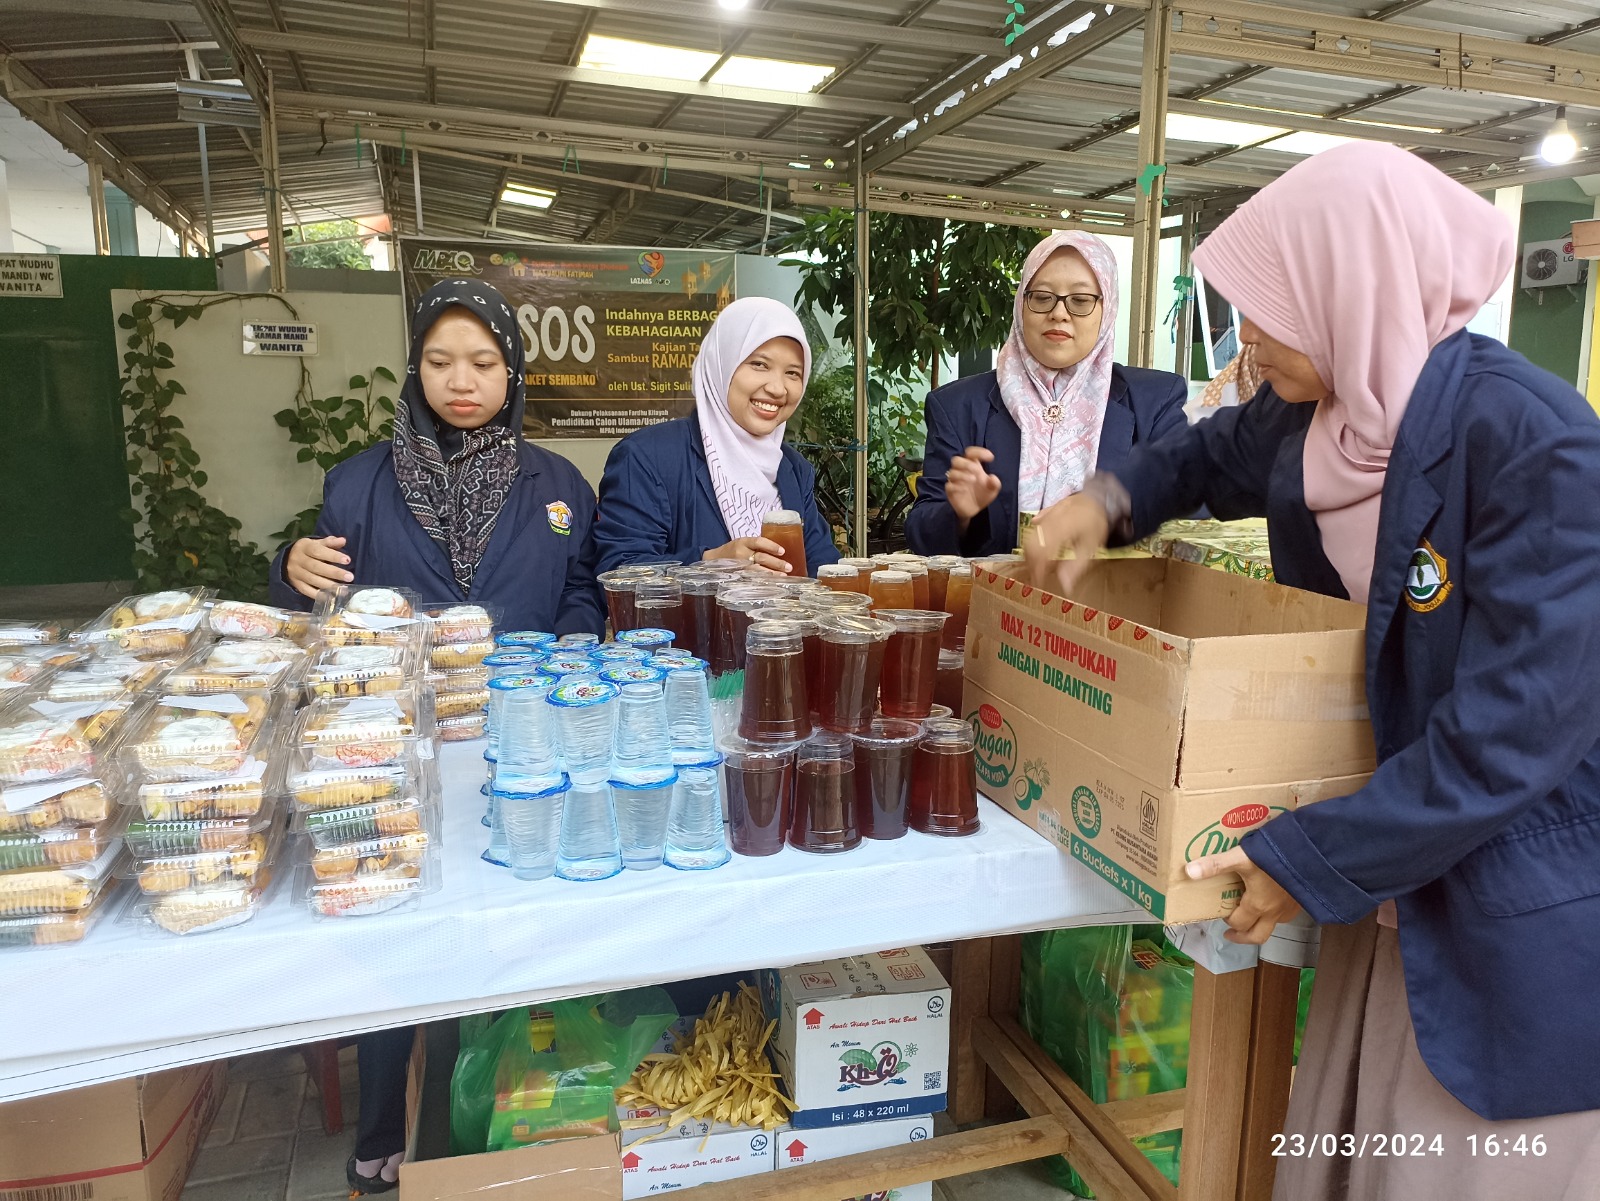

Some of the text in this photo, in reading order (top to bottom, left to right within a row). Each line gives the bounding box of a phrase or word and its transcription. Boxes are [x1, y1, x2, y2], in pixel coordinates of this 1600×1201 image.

[19, 260, 54, 269] WUDHU
[2, 271, 32, 280] MANDI
[40, 272, 54, 281] WC
[605, 309, 721, 324] Indahnya BERBAG
[255, 332, 282, 340] KAMAR
[606, 325, 702, 337] KEBAHAGIAAN
[260, 343, 304, 352] WANITA
[652, 343, 687, 354] Kajian
[607, 353, 649, 363] Sambut
[549, 374, 596, 386] SEMBAKO
[608, 381, 629, 391] oleh
[630, 382, 648, 391] Ust.
[651, 382, 672, 393] Sigit
[552, 418, 594, 426] Pendidikan
[596, 418, 616, 426] Calon
[1001, 611, 1117, 682] MAX 12 TUMPUKAN
[997, 642, 1112, 716] JANGAN DIBANTING
[1226, 806, 1264, 825] WONG COCO
[1057, 834, 1069, 849] SLICE
[1073, 842, 1080, 855] 6
[1082, 846, 1119, 883] Buckets
[1121, 877, 1128, 890] x
[1131, 880, 1135, 895] 1
[1138, 885, 1153, 909] kg
[829, 1022, 848, 1030] Awali
[850, 1021, 870, 1029] Hidup
[871, 1019, 887, 1027] Dari
[841, 1040, 861, 1048] Minum
[832, 1111, 844, 1121] Isi
[853, 1109, 865, 1119] 48
[876, 1105, 894, 1116] 220
[897, 1104, 909, 1114] ml
[661, 1182, 682, 1190] Minum
